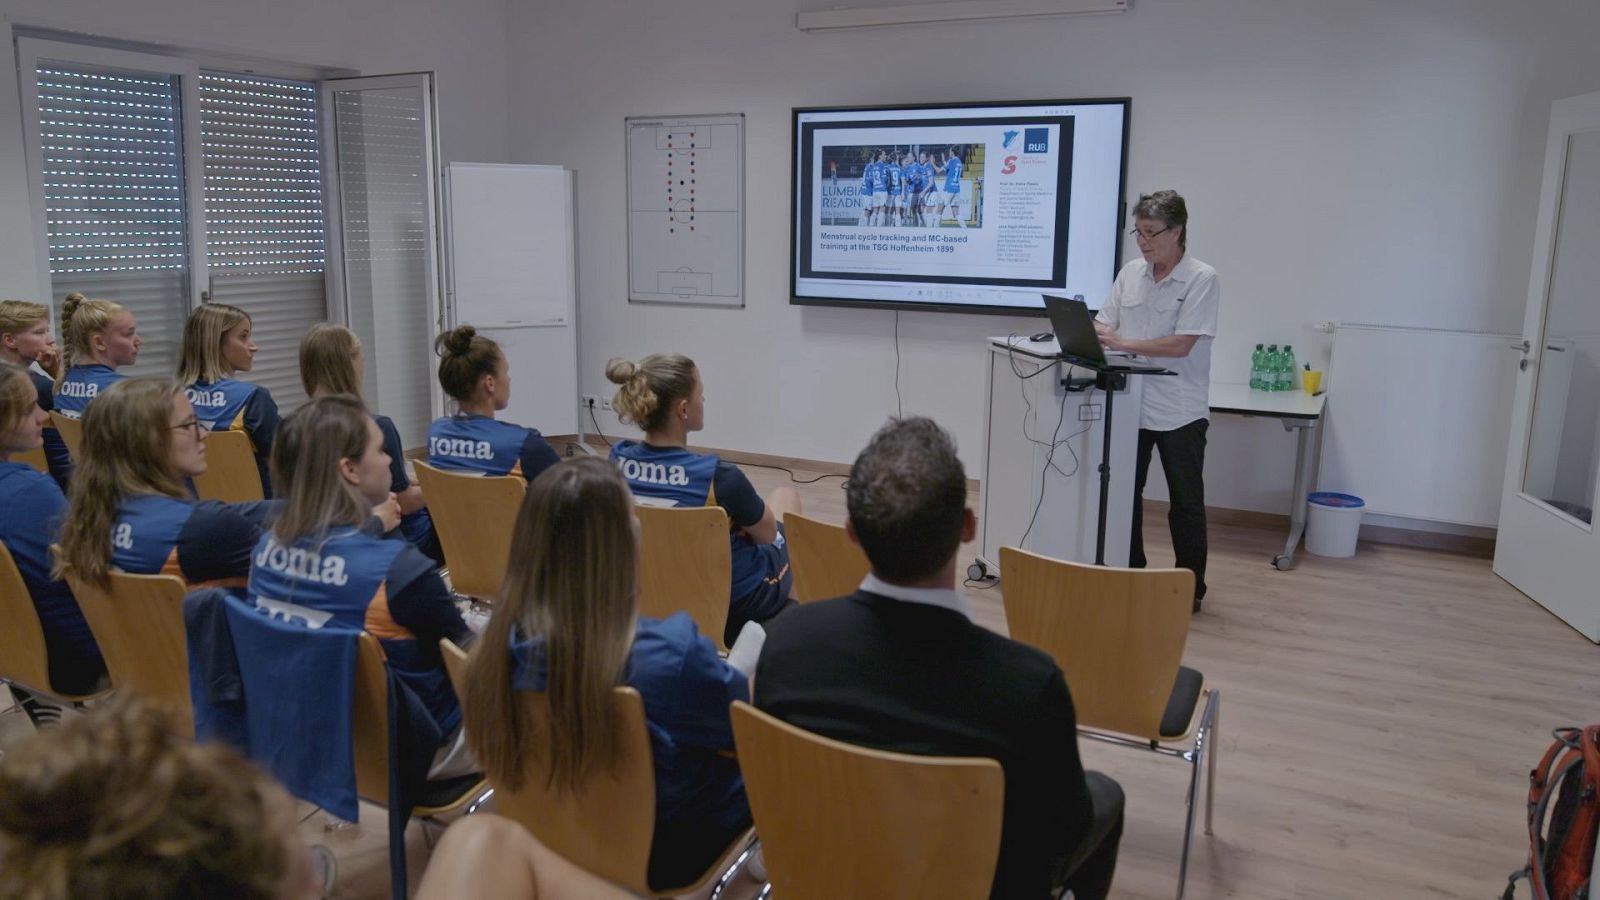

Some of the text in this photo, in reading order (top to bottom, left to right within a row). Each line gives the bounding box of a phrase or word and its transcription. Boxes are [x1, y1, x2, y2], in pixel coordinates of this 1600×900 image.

[1028, 143, 1046, 151] RUB
[892, 171, 899, 185] 9
[820, 232, 857, 241] Menstrual
[858, 233, 878, 242] cycle
[879, 234, 910, 243] tracking
[928, 235, 968, 243] MC-based
[820, 243, 848, 252] training
[873, 243, 889, 251] TSG
[890, 244, 934, 253] Hoffenheim
[936, 245, 955, 253] 1899
[59, 381, 99, 398] oma
[185, 388, 227, 407] oma
[429, 436, 495, 460] Joma
[255, 539, 349, 586] Joma
